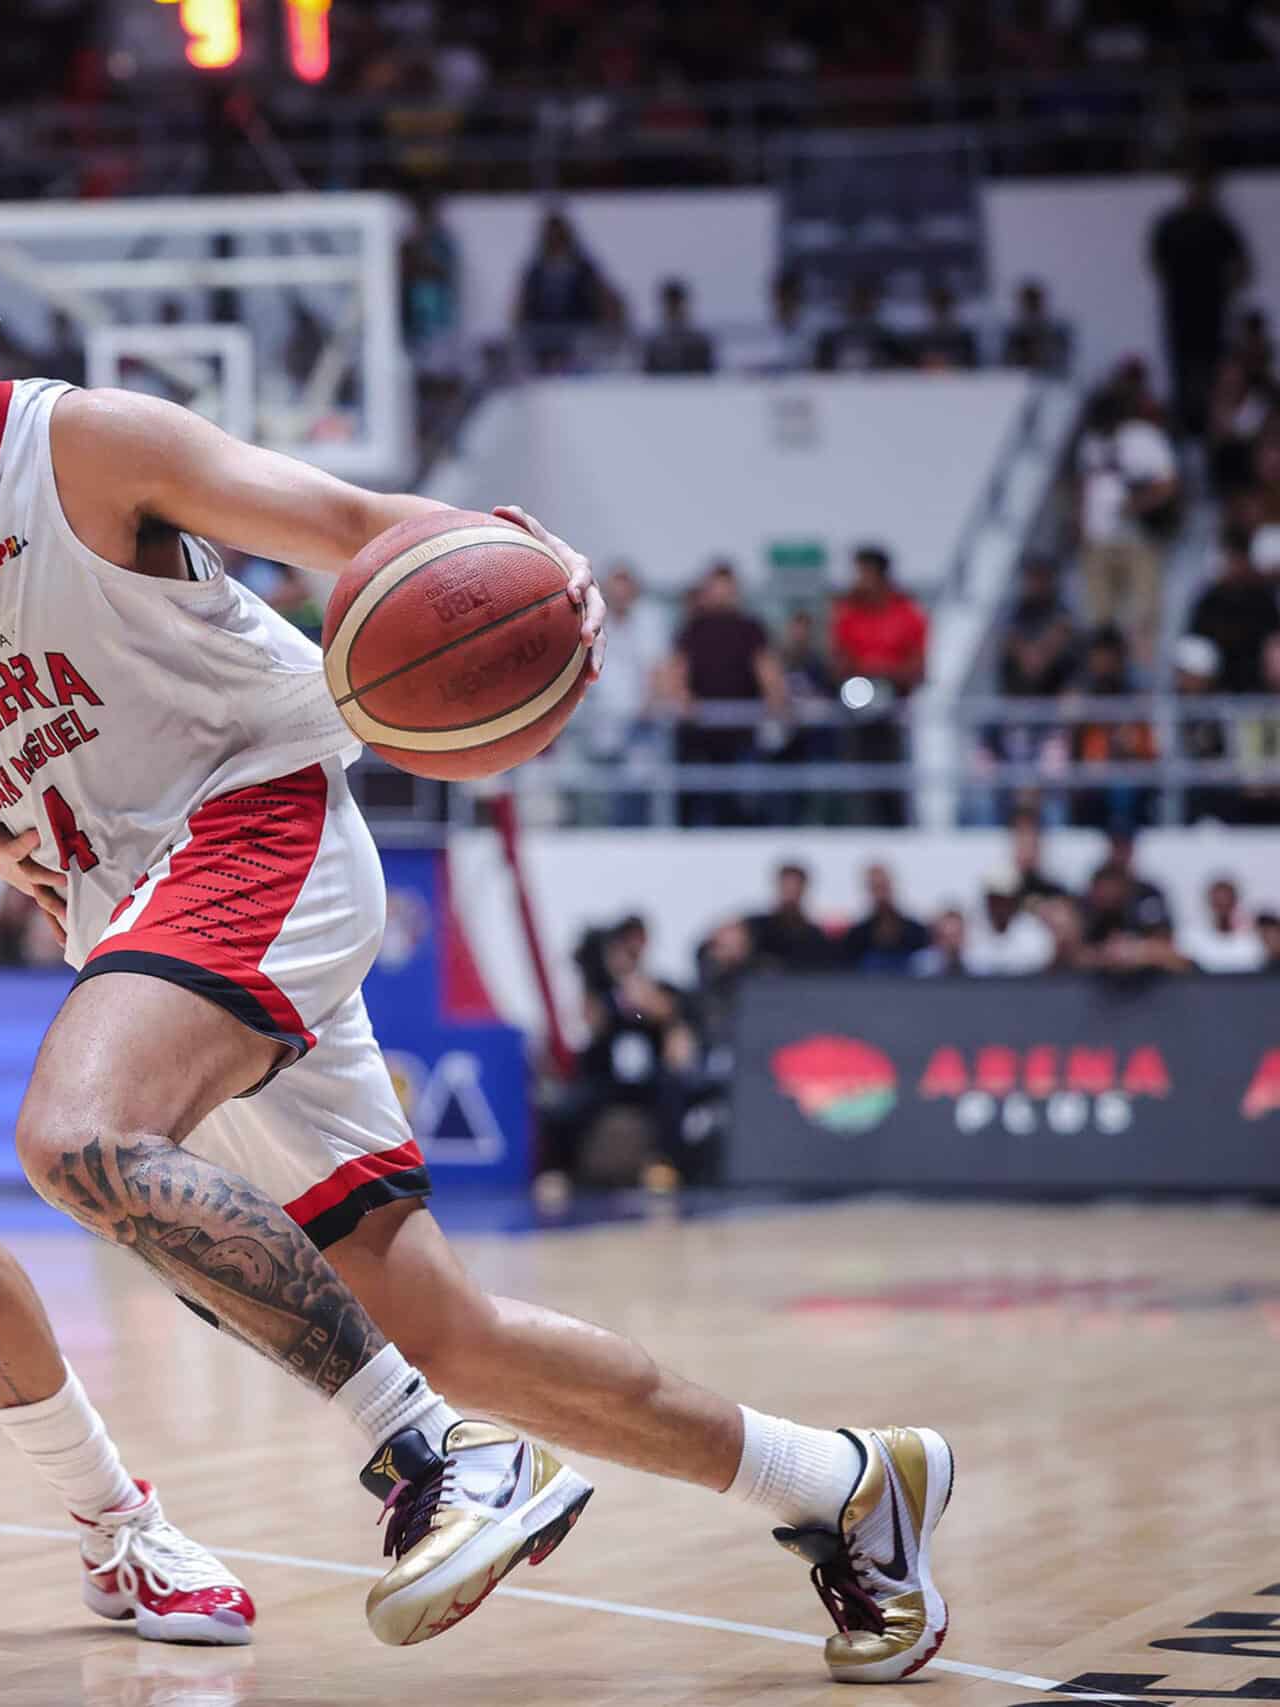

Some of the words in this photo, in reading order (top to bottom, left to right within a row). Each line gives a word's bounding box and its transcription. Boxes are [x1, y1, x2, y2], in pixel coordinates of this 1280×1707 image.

[41, 784, 100, 873] 4
[919, 1043, 1171, 1099] ARENA
[954, 1089, 1133, 1136] PLUS
